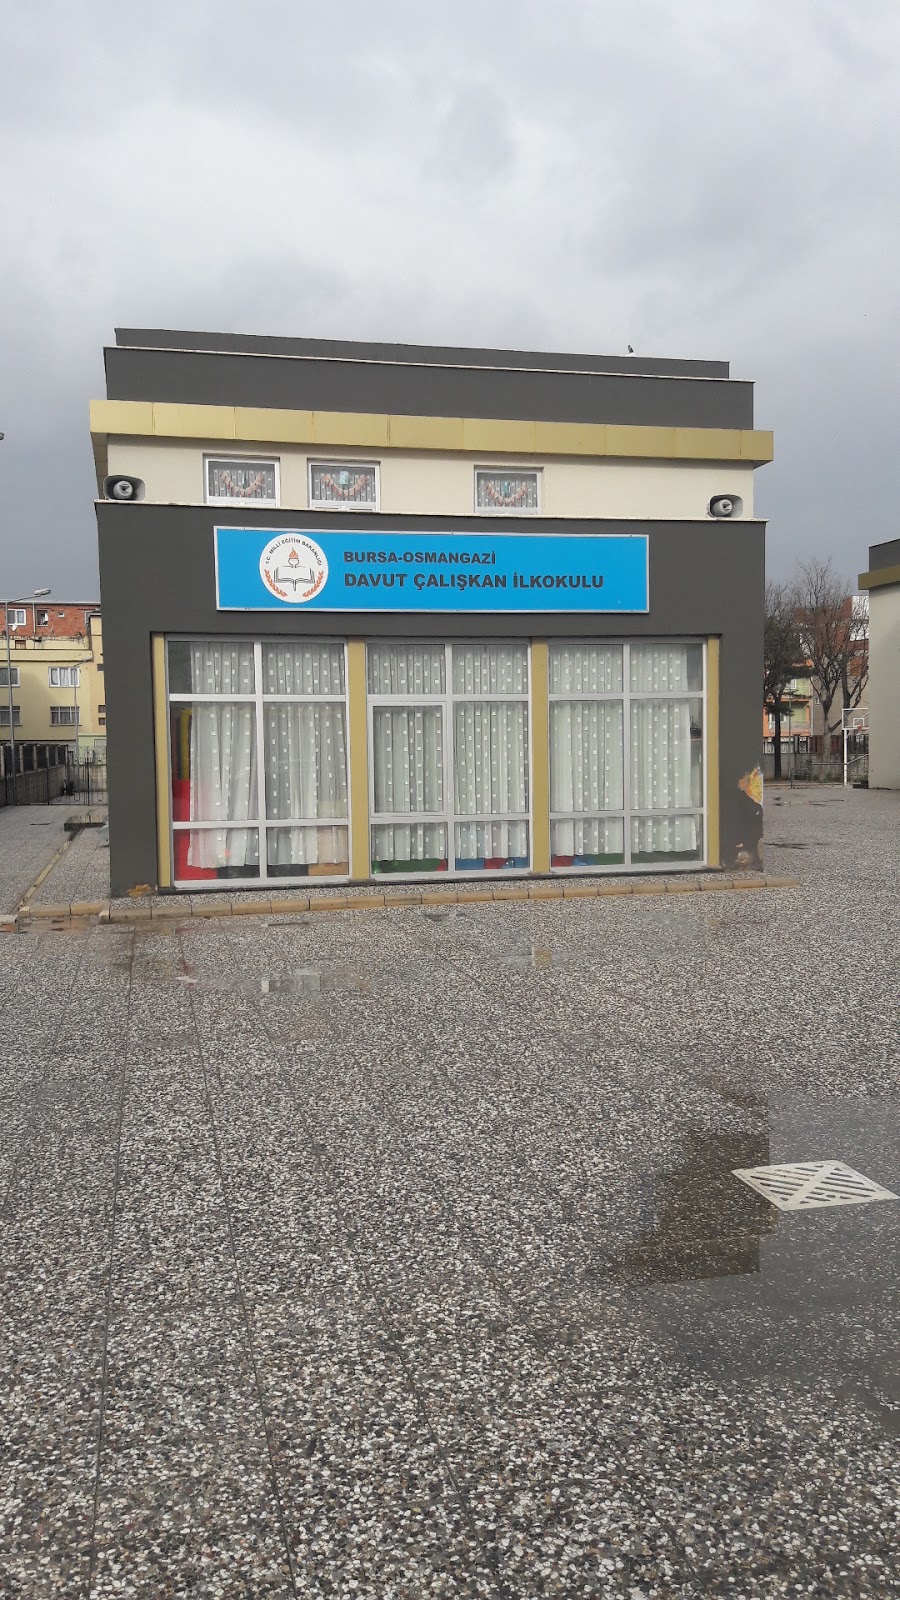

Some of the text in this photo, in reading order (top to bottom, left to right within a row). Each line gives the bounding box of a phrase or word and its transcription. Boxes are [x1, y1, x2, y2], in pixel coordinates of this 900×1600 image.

[269, 541, 281, 554] MİLLİ
[281, 536, 300, 545] EĞİTİM
[301, 540, 322, 566] BAKANLIĞI
[343, 550, 496, 565] BURSA-OSMANGAZİ
[344, 571, 604, 591] DAVUT ÇALIŞKAN İLKOKULU
